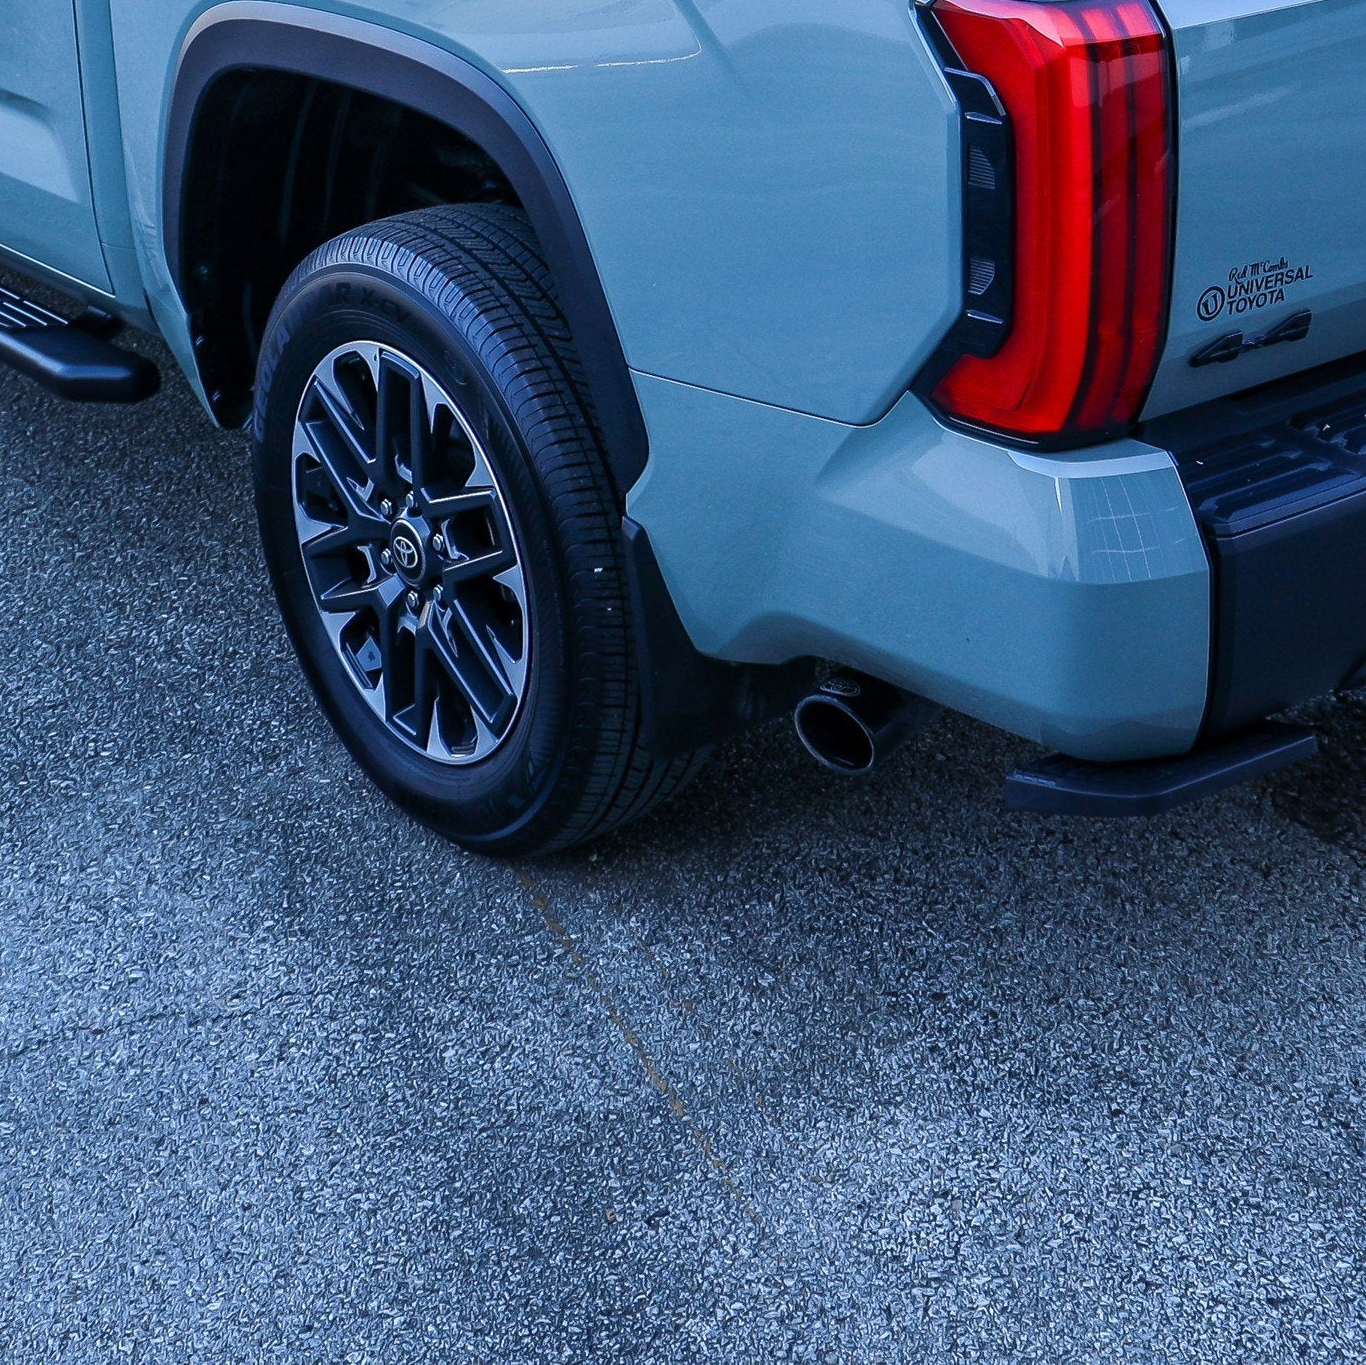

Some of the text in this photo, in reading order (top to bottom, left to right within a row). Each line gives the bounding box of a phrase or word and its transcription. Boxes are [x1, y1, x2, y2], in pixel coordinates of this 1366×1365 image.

[1227, 265, 1314, 299] UNIVERSAL
[1228, 266, 1248, 285] Red
[1227, 288, 1285, 315] TOYOTA
